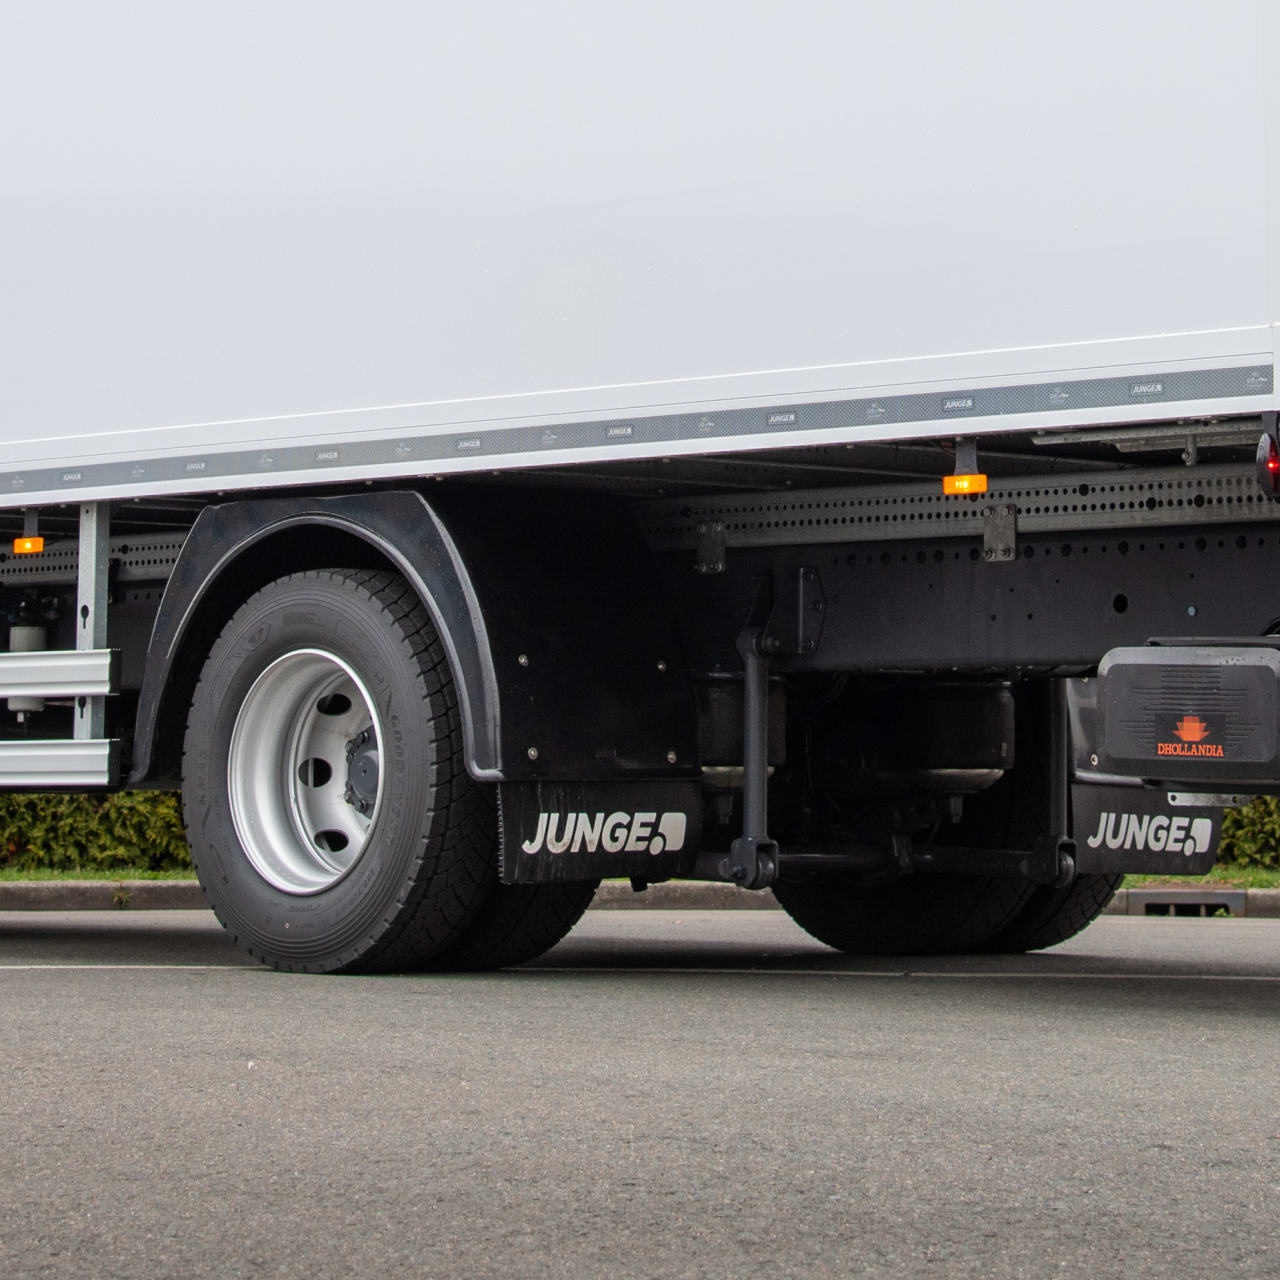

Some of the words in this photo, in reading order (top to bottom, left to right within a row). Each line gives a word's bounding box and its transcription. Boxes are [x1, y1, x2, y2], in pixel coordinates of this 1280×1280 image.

[1133, 385, 1157, 393] JUNGE
[944, 400, 967, 408] JUNGE
[1157, 743, 1224, 757] DHOLLANDIA
[522, 812, 657, 854] JUNGE
[1087, 812, 1190, 852] JUNGE
